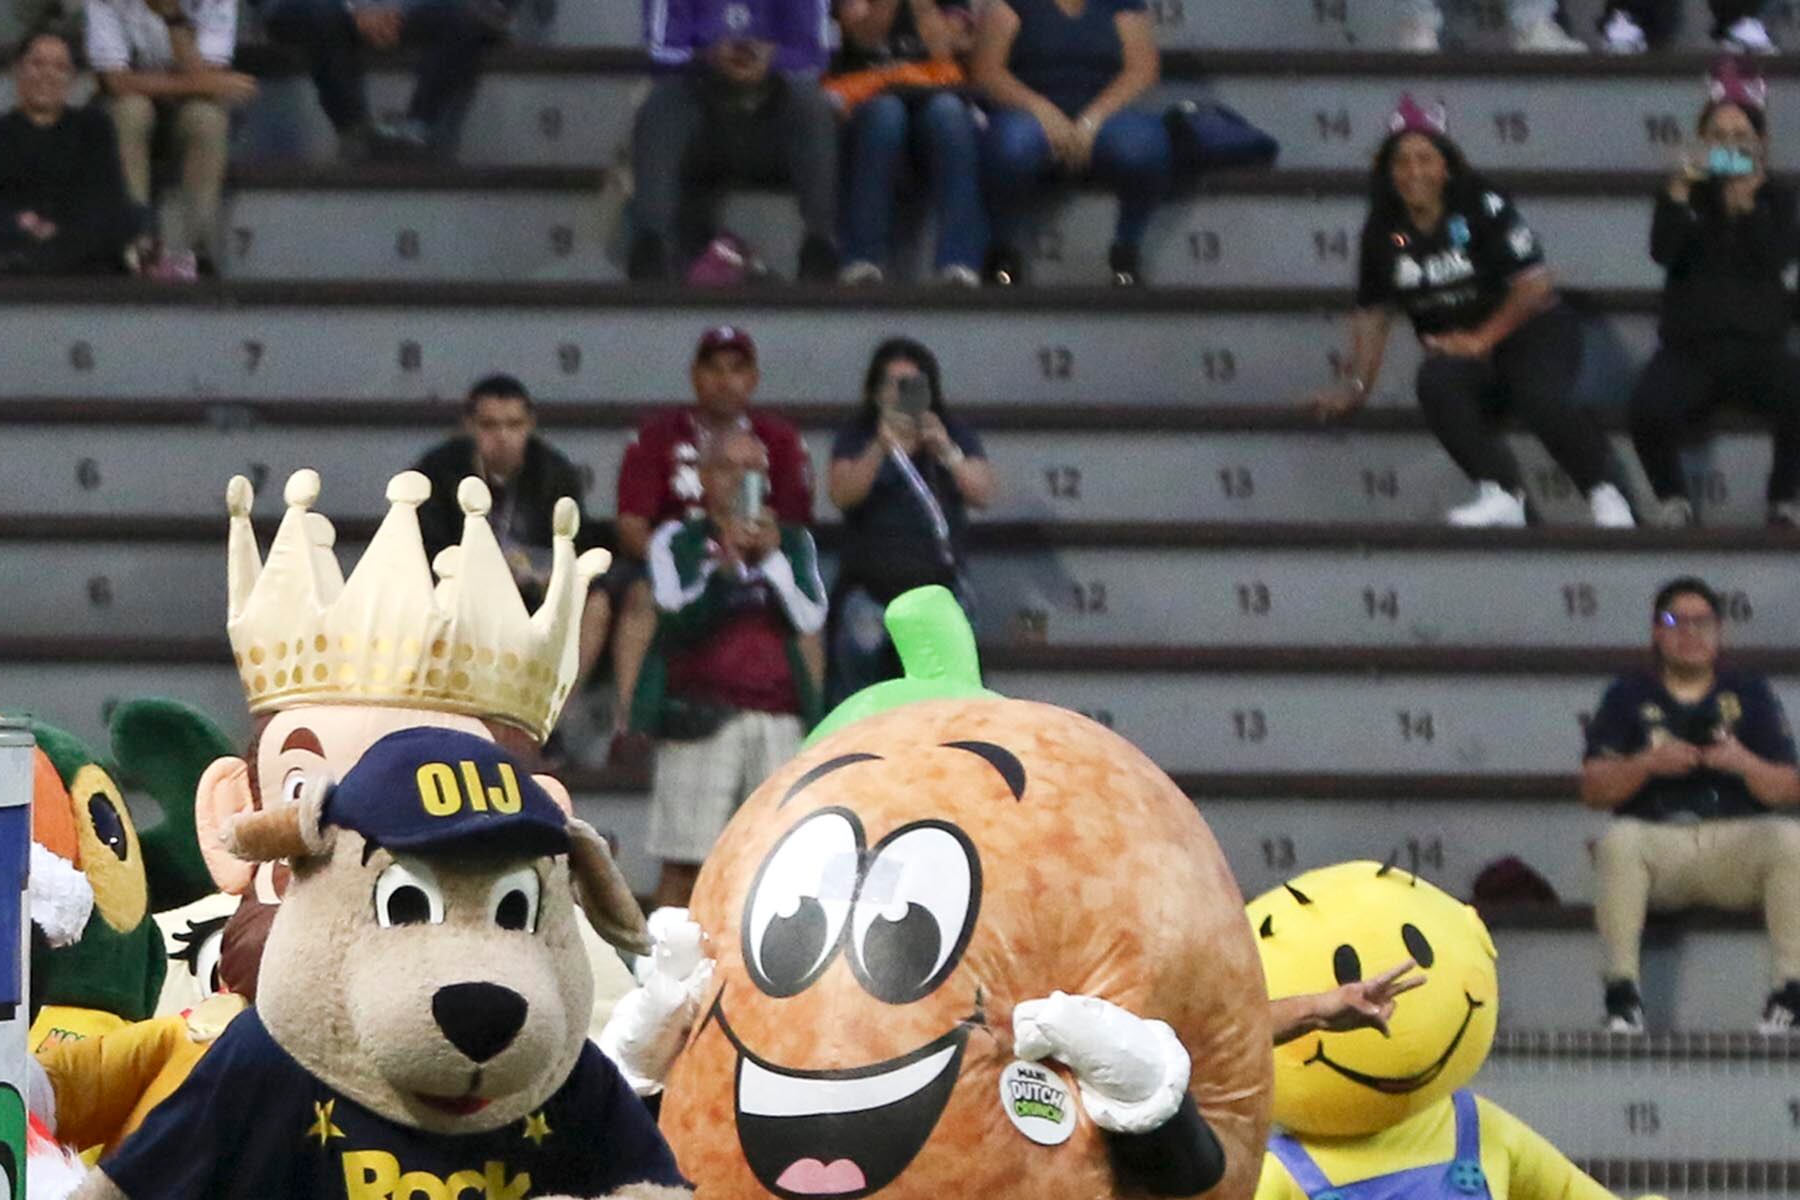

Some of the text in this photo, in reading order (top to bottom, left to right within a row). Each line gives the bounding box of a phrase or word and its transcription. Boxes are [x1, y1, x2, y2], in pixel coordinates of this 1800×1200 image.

[1316, 110, 1351, 140] 14
[1495, 110, 1528, 142] 15
[1646, 115, 1681, 142] 16
[234, 226, 253, 257] 7
[1188, 230, 1221, 262] 13
[1313, 229, 1348, 261] 14
[68, 340, 95, 372] 6
[244, 338, 264, 375] 7
[558, 342, 582, 375] 9
[1037, 347, 1073, 379] 12
[1202, 347, 1236, 380] 13
[75, 457, 100, 491] 6
[1045, 466, 1081, 500] 12
[1218, 466, 1254, 500] 13
[1362, 467, 1398, 499] 14
[87, 575, 113, 608] 6
[1073, 581, 1108, 616] 12
[1237, 581, 1271, 617] 13
[1362, 585, 1399, 620] 14
[1563, 583, 1598, 617] 15
[1233, 708, 1435, 742] 13 14
[416, 760, 523, 817] OIJ
[1262, 836, 1297, 869] 13
[1008, 1079, 1065, 1109] DUTCH
